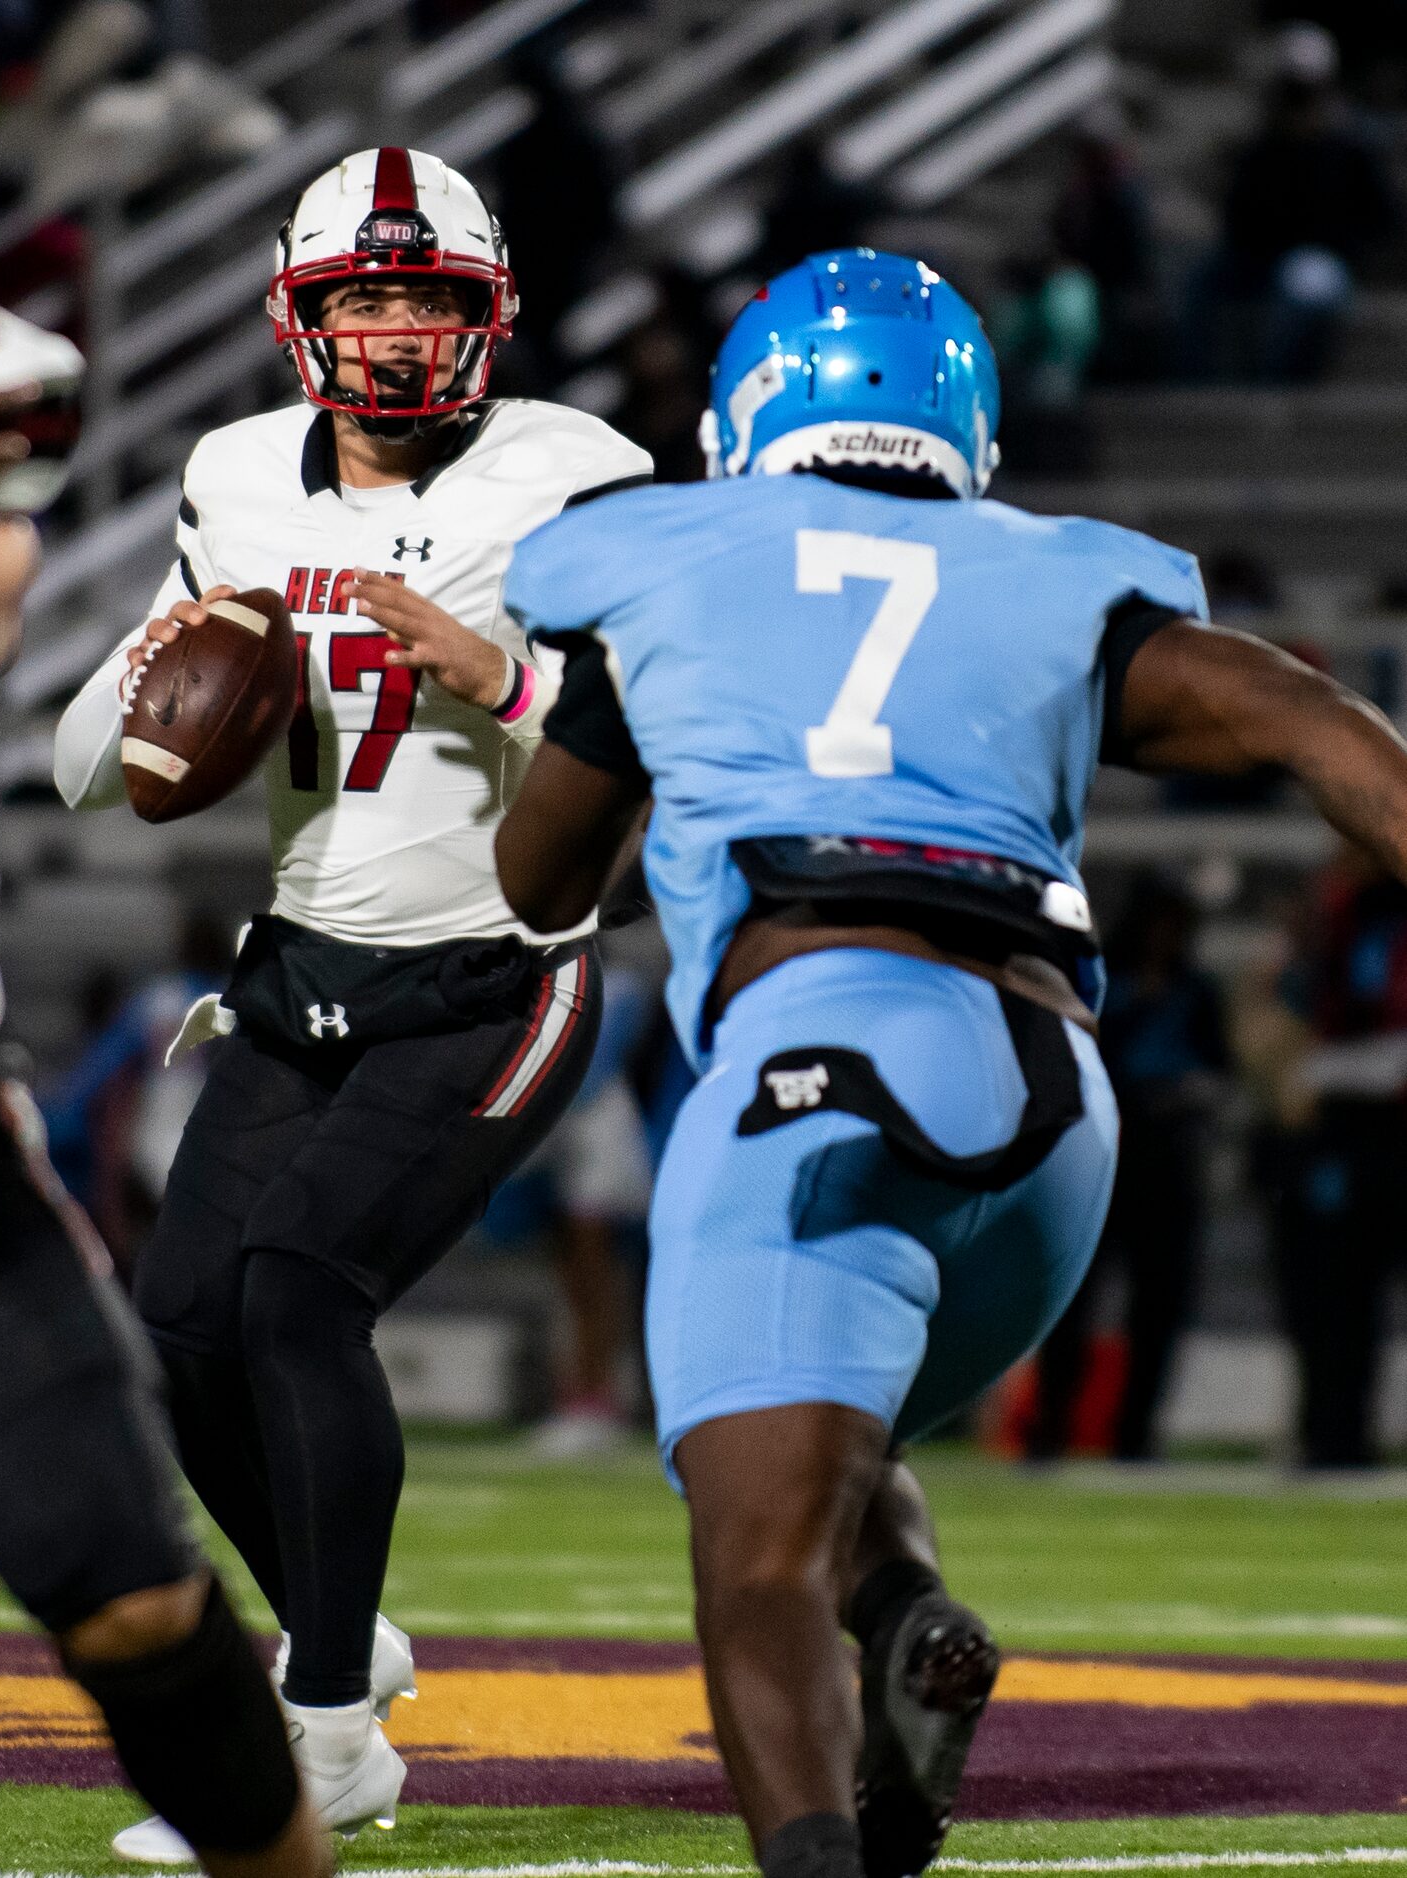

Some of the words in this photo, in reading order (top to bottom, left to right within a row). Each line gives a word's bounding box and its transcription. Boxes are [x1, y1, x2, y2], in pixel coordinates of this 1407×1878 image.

[378, 225, 412, 240] WTD
[828, 430, 922, 457] schutt
[285, 567, 406, 614] HEA
[796, 529, 938, 777] 7
